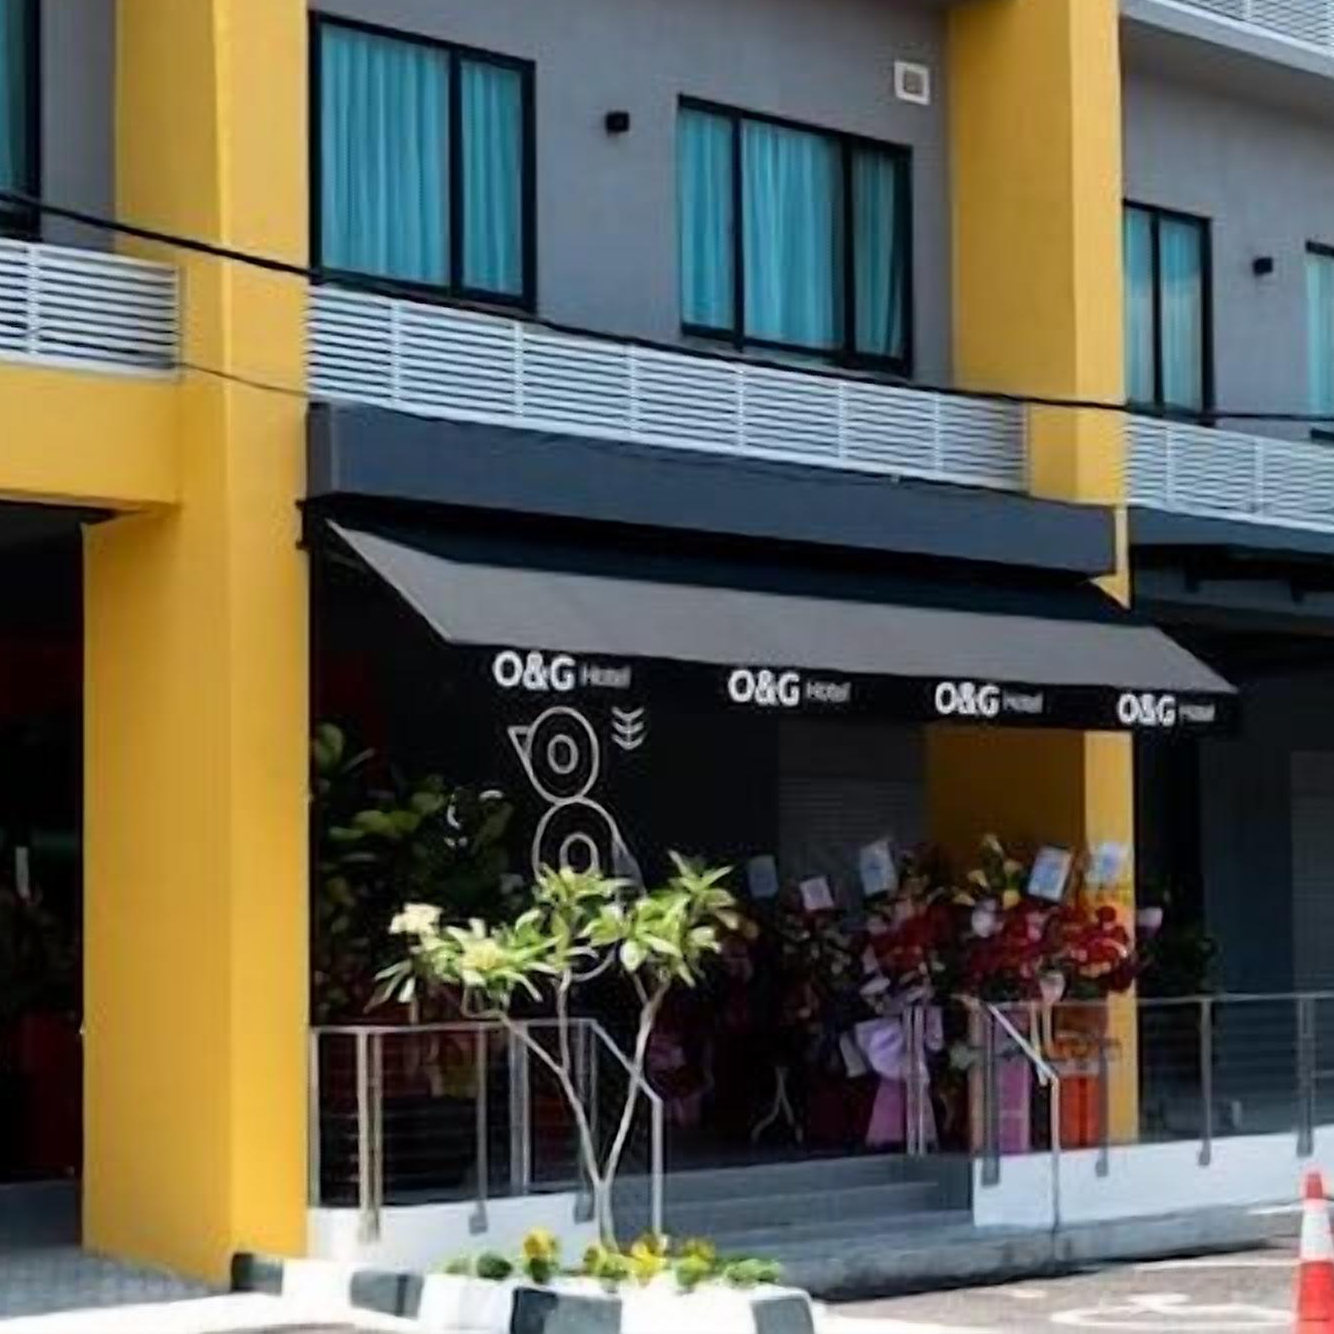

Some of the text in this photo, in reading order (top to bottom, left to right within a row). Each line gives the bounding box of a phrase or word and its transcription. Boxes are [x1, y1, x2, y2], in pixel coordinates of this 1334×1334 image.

[492, 650, 576, 691] O&G
[728, 669, 800, 707] O&G
[935, 681, 1000, 717] O&G
[1118, 693, 1176, 727] O&G
